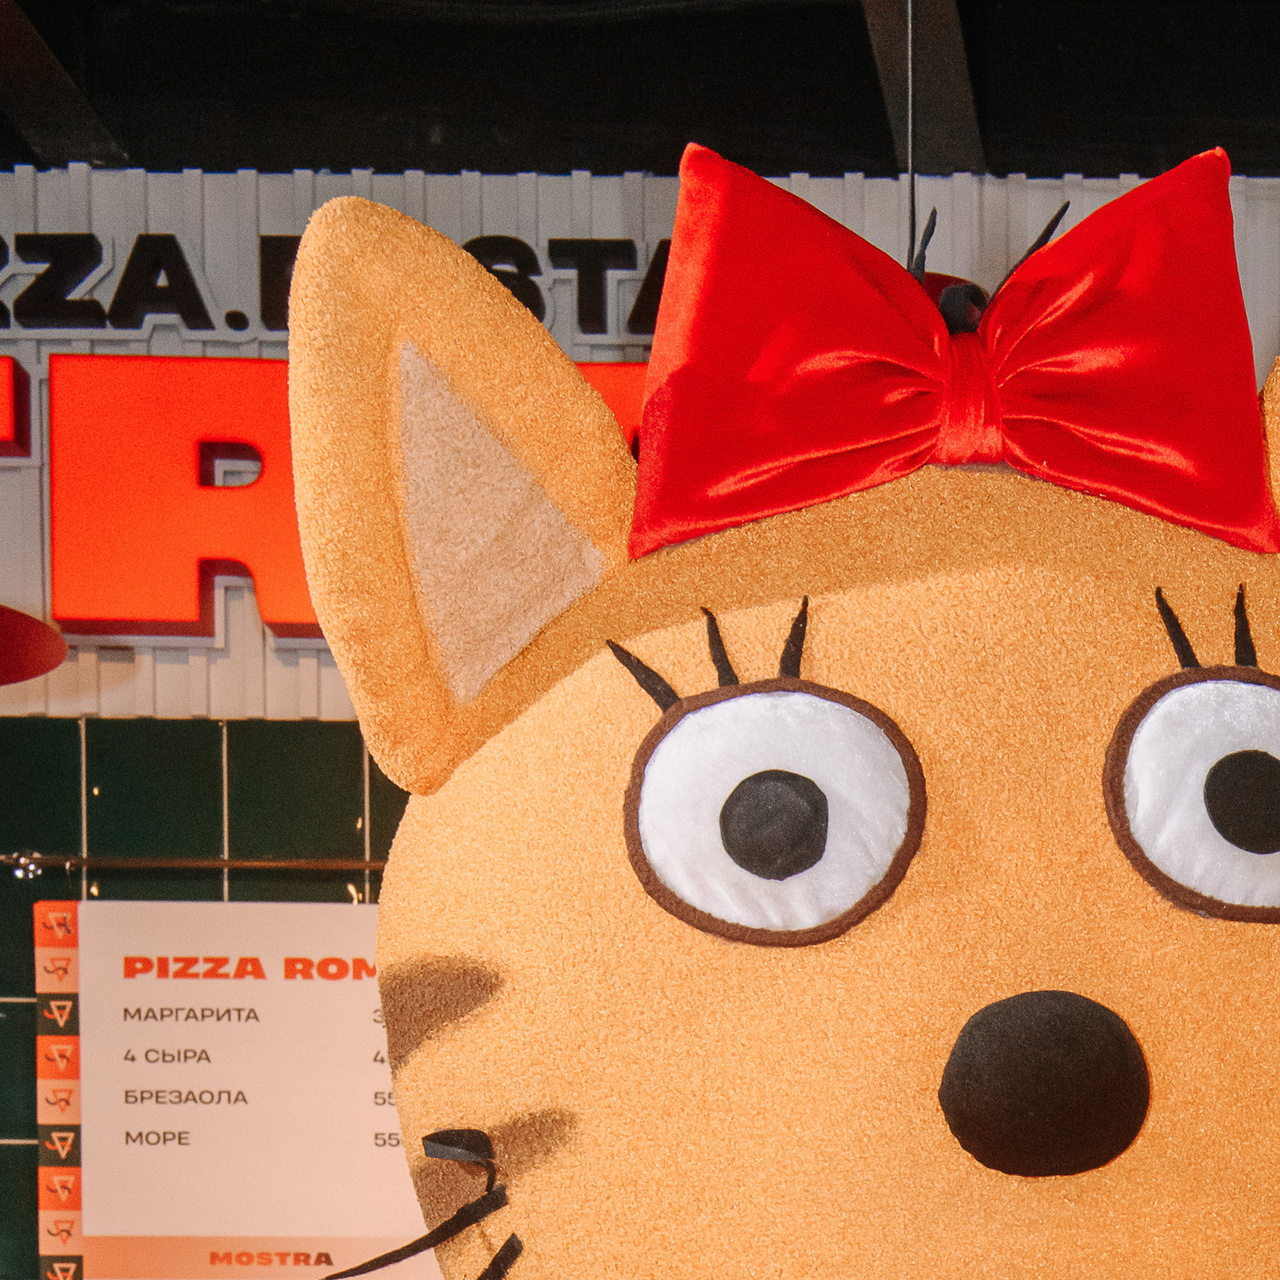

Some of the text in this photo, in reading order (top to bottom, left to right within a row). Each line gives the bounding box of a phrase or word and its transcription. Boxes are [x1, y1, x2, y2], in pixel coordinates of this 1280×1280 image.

[123, 956, 377, 981] PIZZA ROM
[123, 1007, 260, 1023] МАРГАРИТА
[123, 1049, 211, 1064] 4 СЫРА
[124, 1089, 397, 1107] БРЕЗАОЛА 55
[125, 1131, 401, 1148] МОРЕ 55
[209, 1252, 334, 1267] MOSTRA
